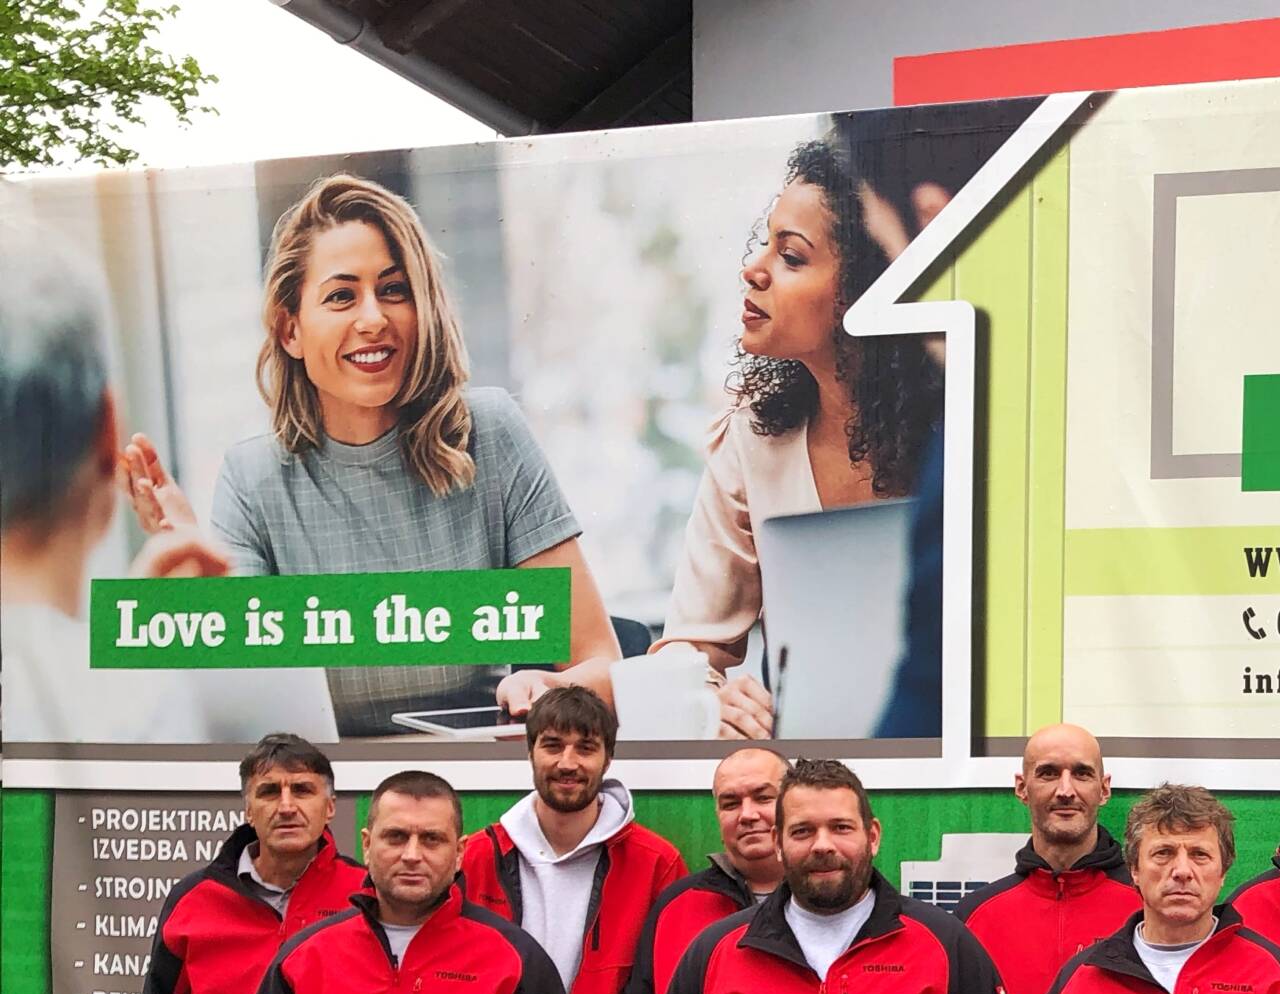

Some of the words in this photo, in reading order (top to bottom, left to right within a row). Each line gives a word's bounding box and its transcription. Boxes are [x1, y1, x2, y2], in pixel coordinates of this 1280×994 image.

[115, 600, 226, 648] Love
[245, 597, 284, 646] is
[303, 595, 354, 645] in
[373, 594, 452, 644] the
[472, 591, 545, 642] air
[93, 838, 188, 862] IZVEDBA
[95, 876, 181, 901] STROJN
